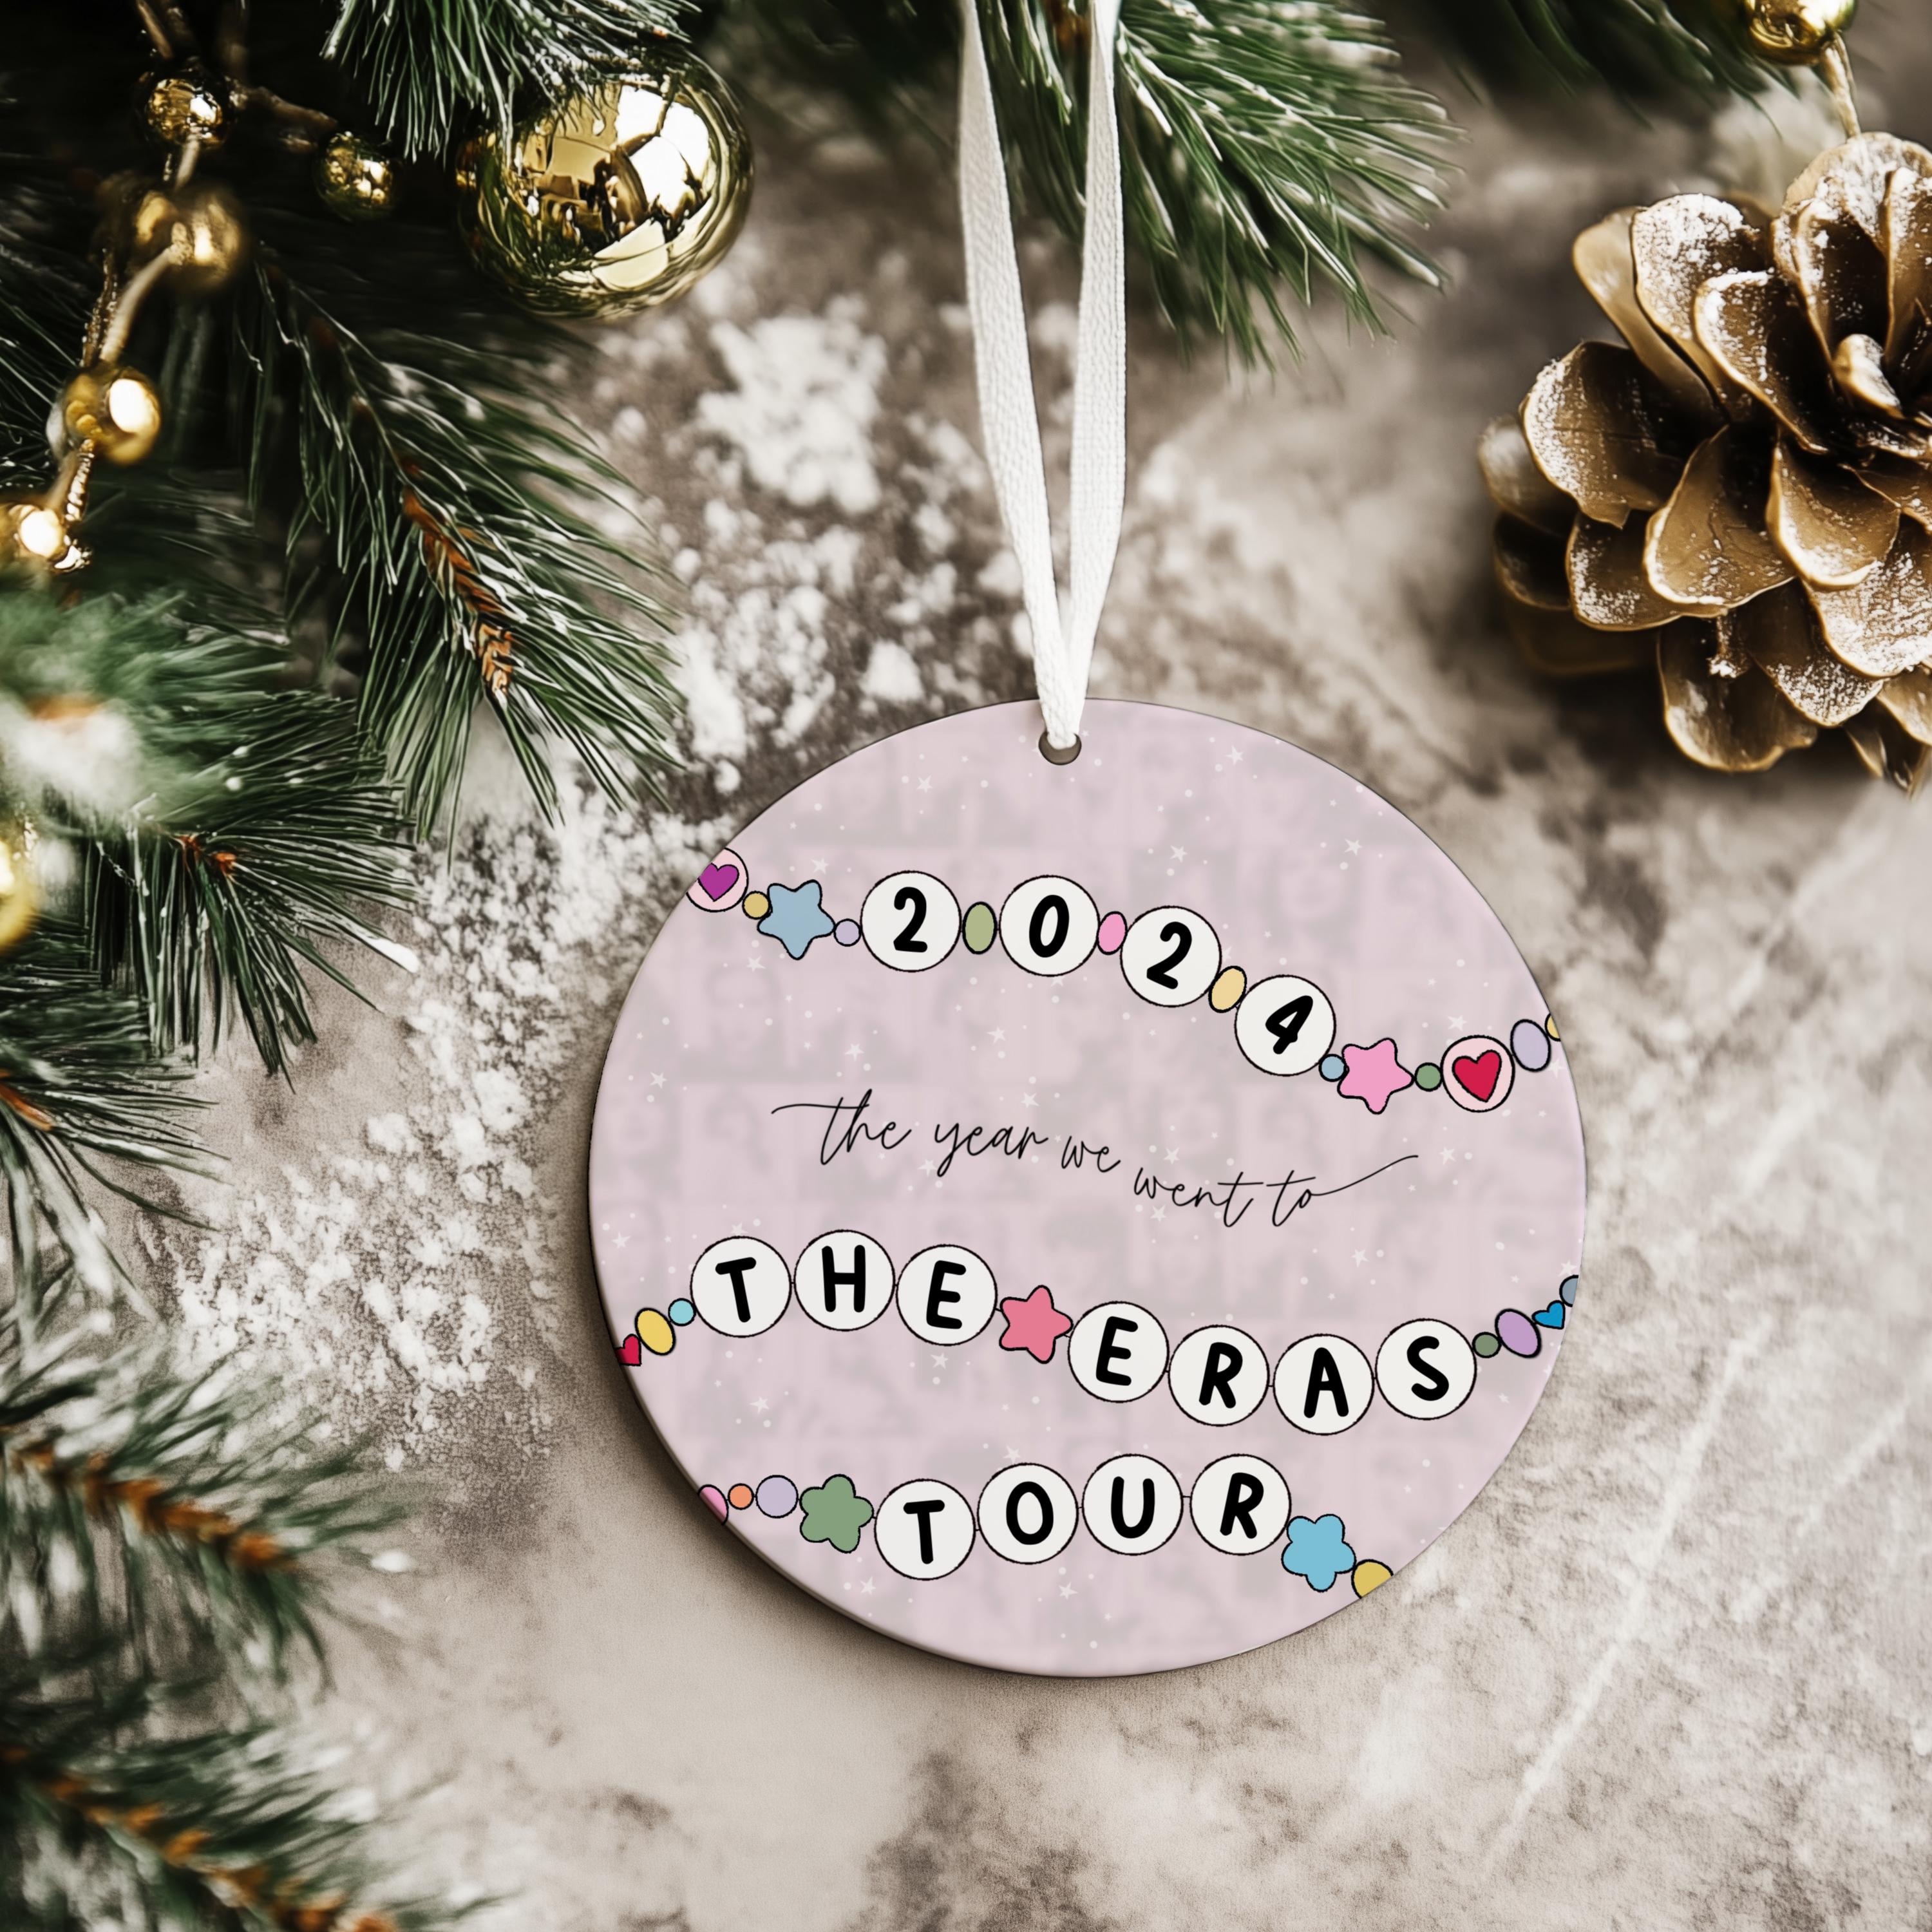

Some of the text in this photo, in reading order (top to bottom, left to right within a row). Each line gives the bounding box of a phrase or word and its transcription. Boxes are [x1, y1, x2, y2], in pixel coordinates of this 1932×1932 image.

[893, 886, 1314, 1056] 2024
[771, 1088, 1419, 1227] the year we went to
[714, 1244, 1450, 1419] THE ERAS
[902, 1472, 1265, 1566] TOUR
